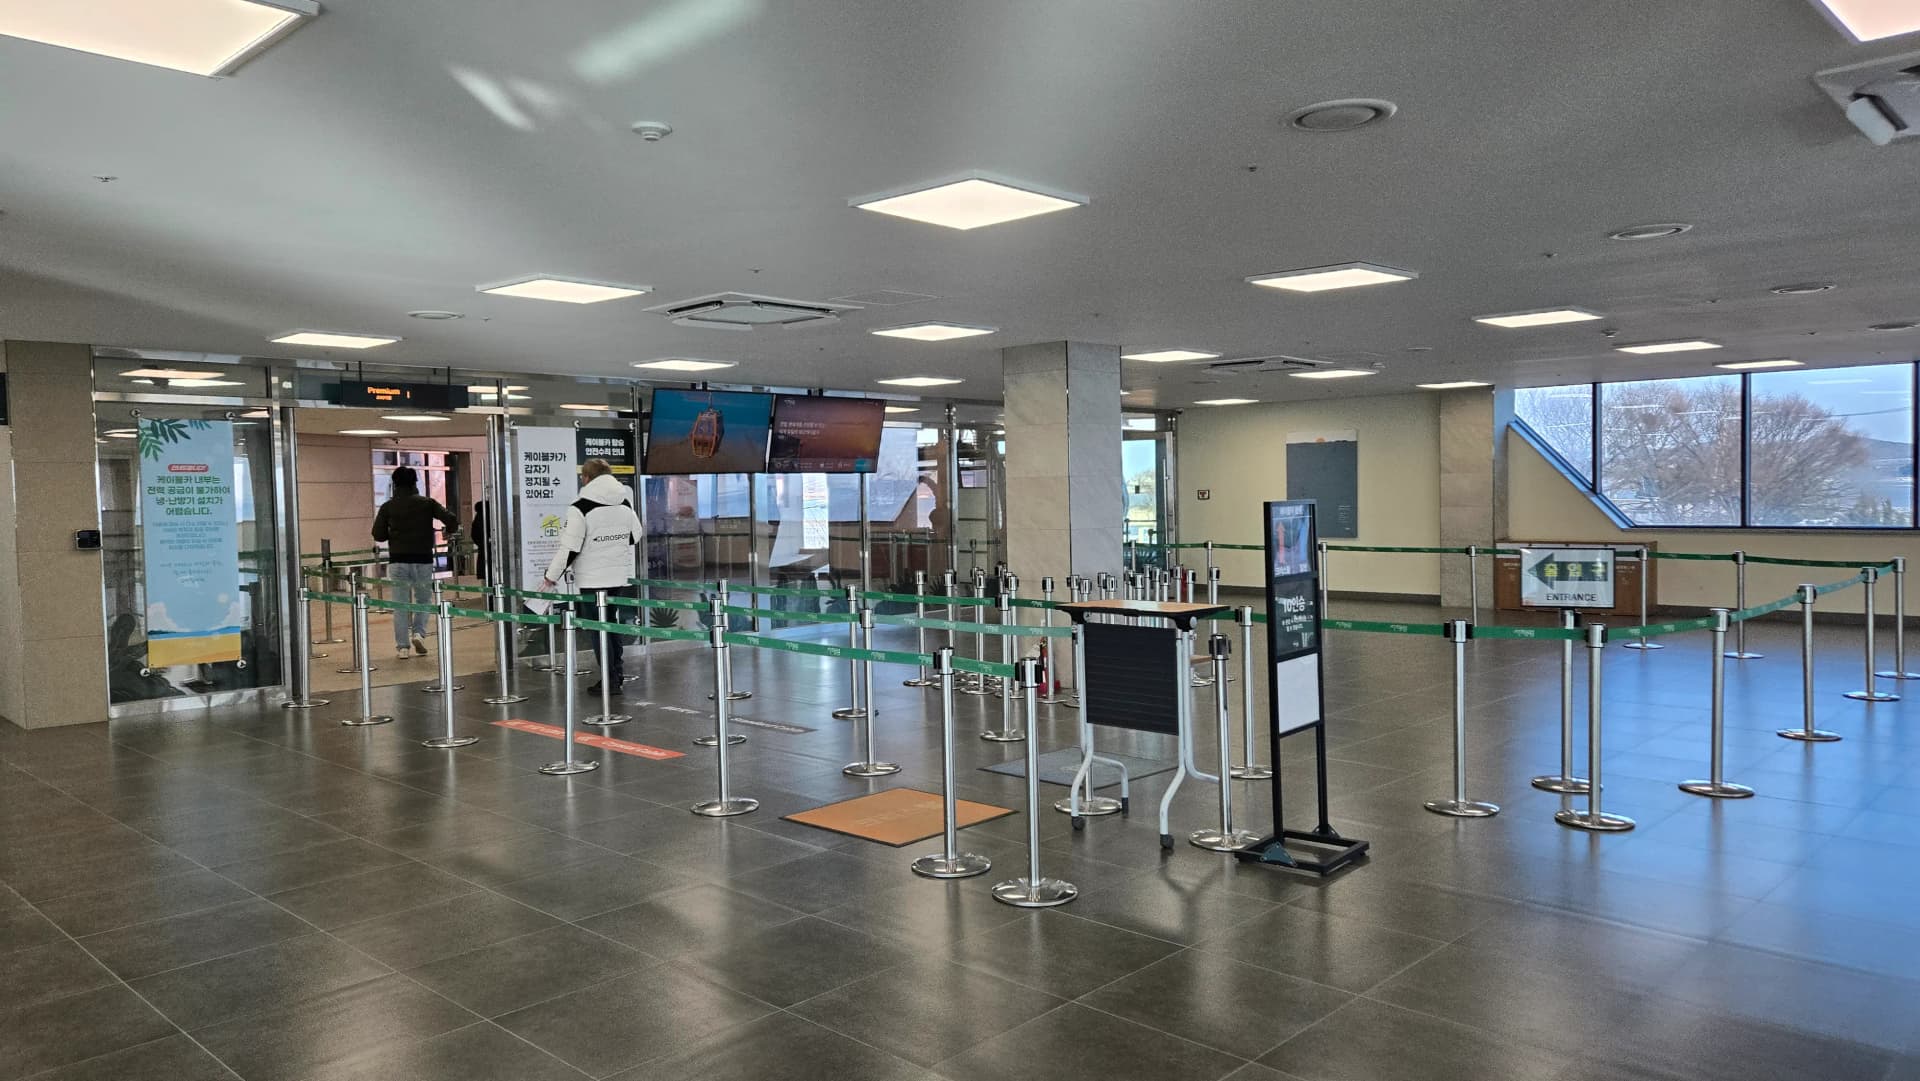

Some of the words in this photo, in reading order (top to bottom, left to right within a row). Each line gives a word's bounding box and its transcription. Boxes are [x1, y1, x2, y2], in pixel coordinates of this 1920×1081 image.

[367, 386, 401, 395] Premium
[585, 438, 611, 447] 케이블카
[612, 438, 625, 447] 탑승
[585, 447, 611, 456] 안전수칙
[612, 447, 625, 456] 안내
[524, 451, 566, 462] 케이블카가
[524, 464, 550, 474] 갑자기
[156, 475, 193, 484] 케이블카
[194, 475, 222, 484] 내부는
[525, 476, 551, 487] 정지될
[552, 476, 561, 487] 수
[147, 486, 165, 495] 전력
[167, 486, 194, 495] 공급이
[196, 486, 230, 495] 불가하여
[526, 489, 553, 499] 있어요!
[197, 496, 223, 505] 설치가
[166, 507, 213, 516] 어렵습니다.
[1546, 593, 1598, 602] ENTRANCE
